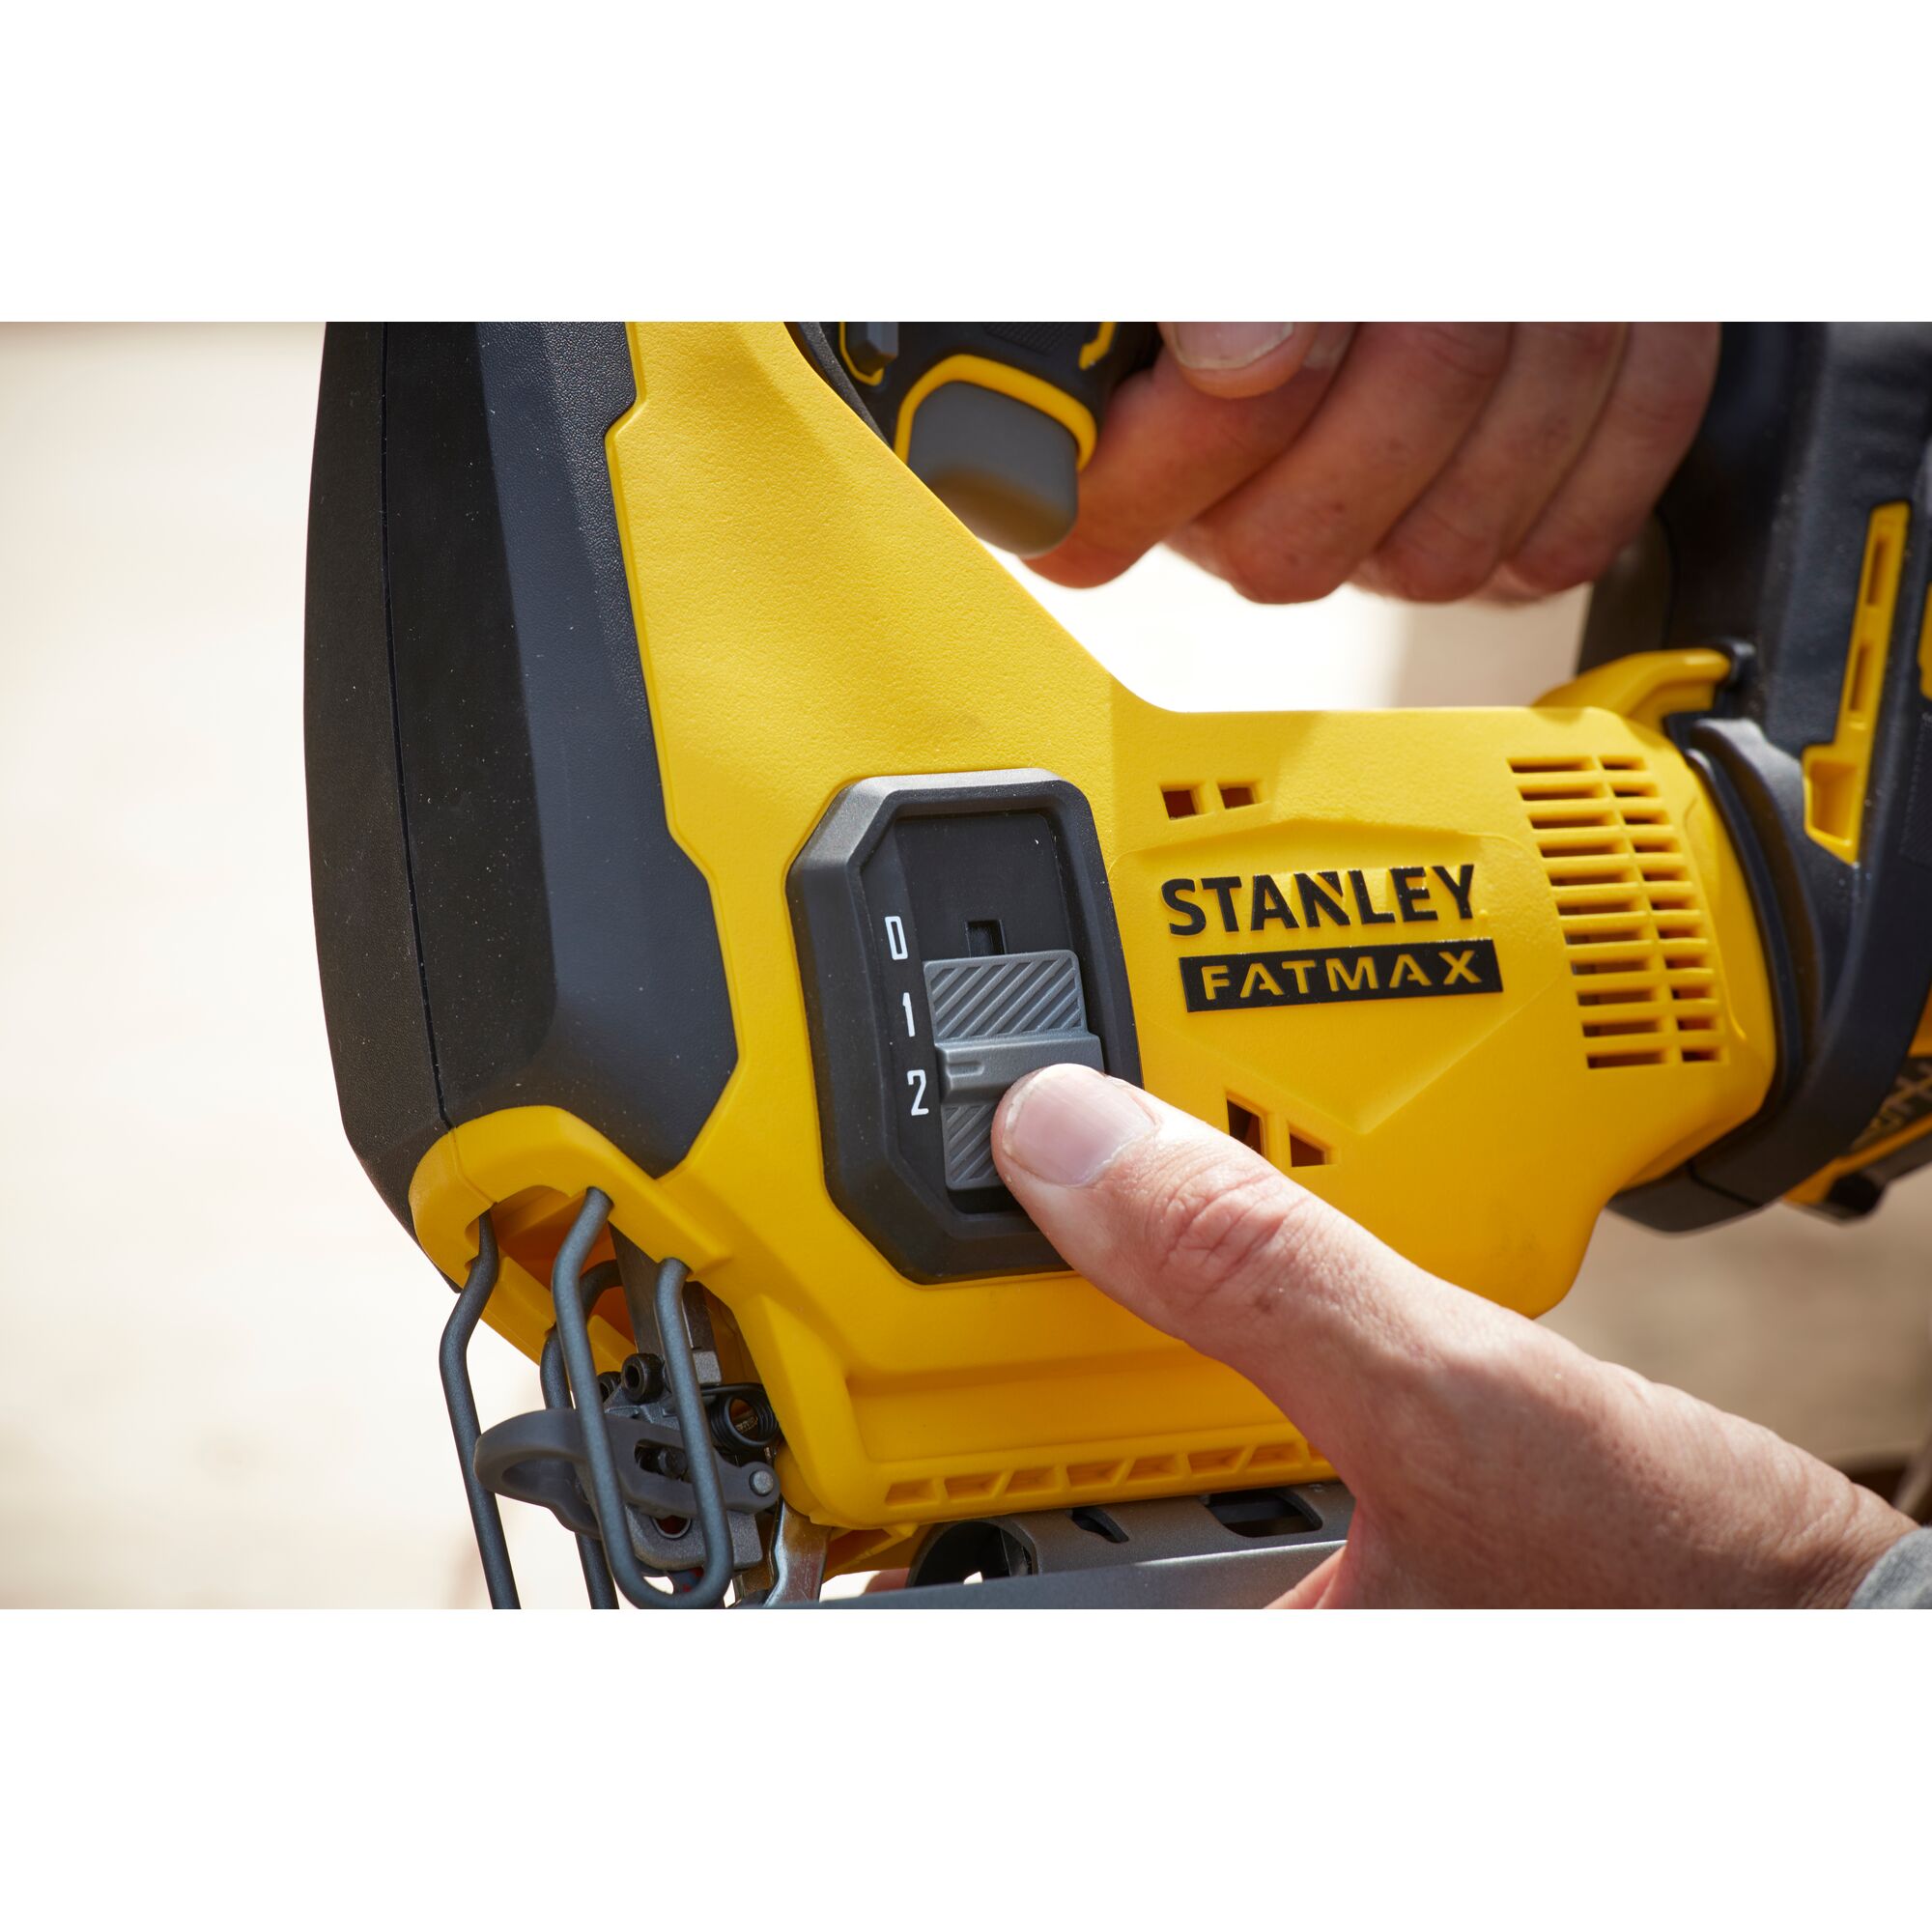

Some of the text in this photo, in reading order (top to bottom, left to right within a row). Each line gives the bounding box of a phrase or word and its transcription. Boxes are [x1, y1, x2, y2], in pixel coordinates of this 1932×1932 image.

[1161, 865, 1474, 937] STANLEY
[884, 916, 908, 960] 0
[1201, 950, 1482, 1000] FATMAX
[902, 991, 916, 1037] 1
[906, 1069, 929, 1116] 2
